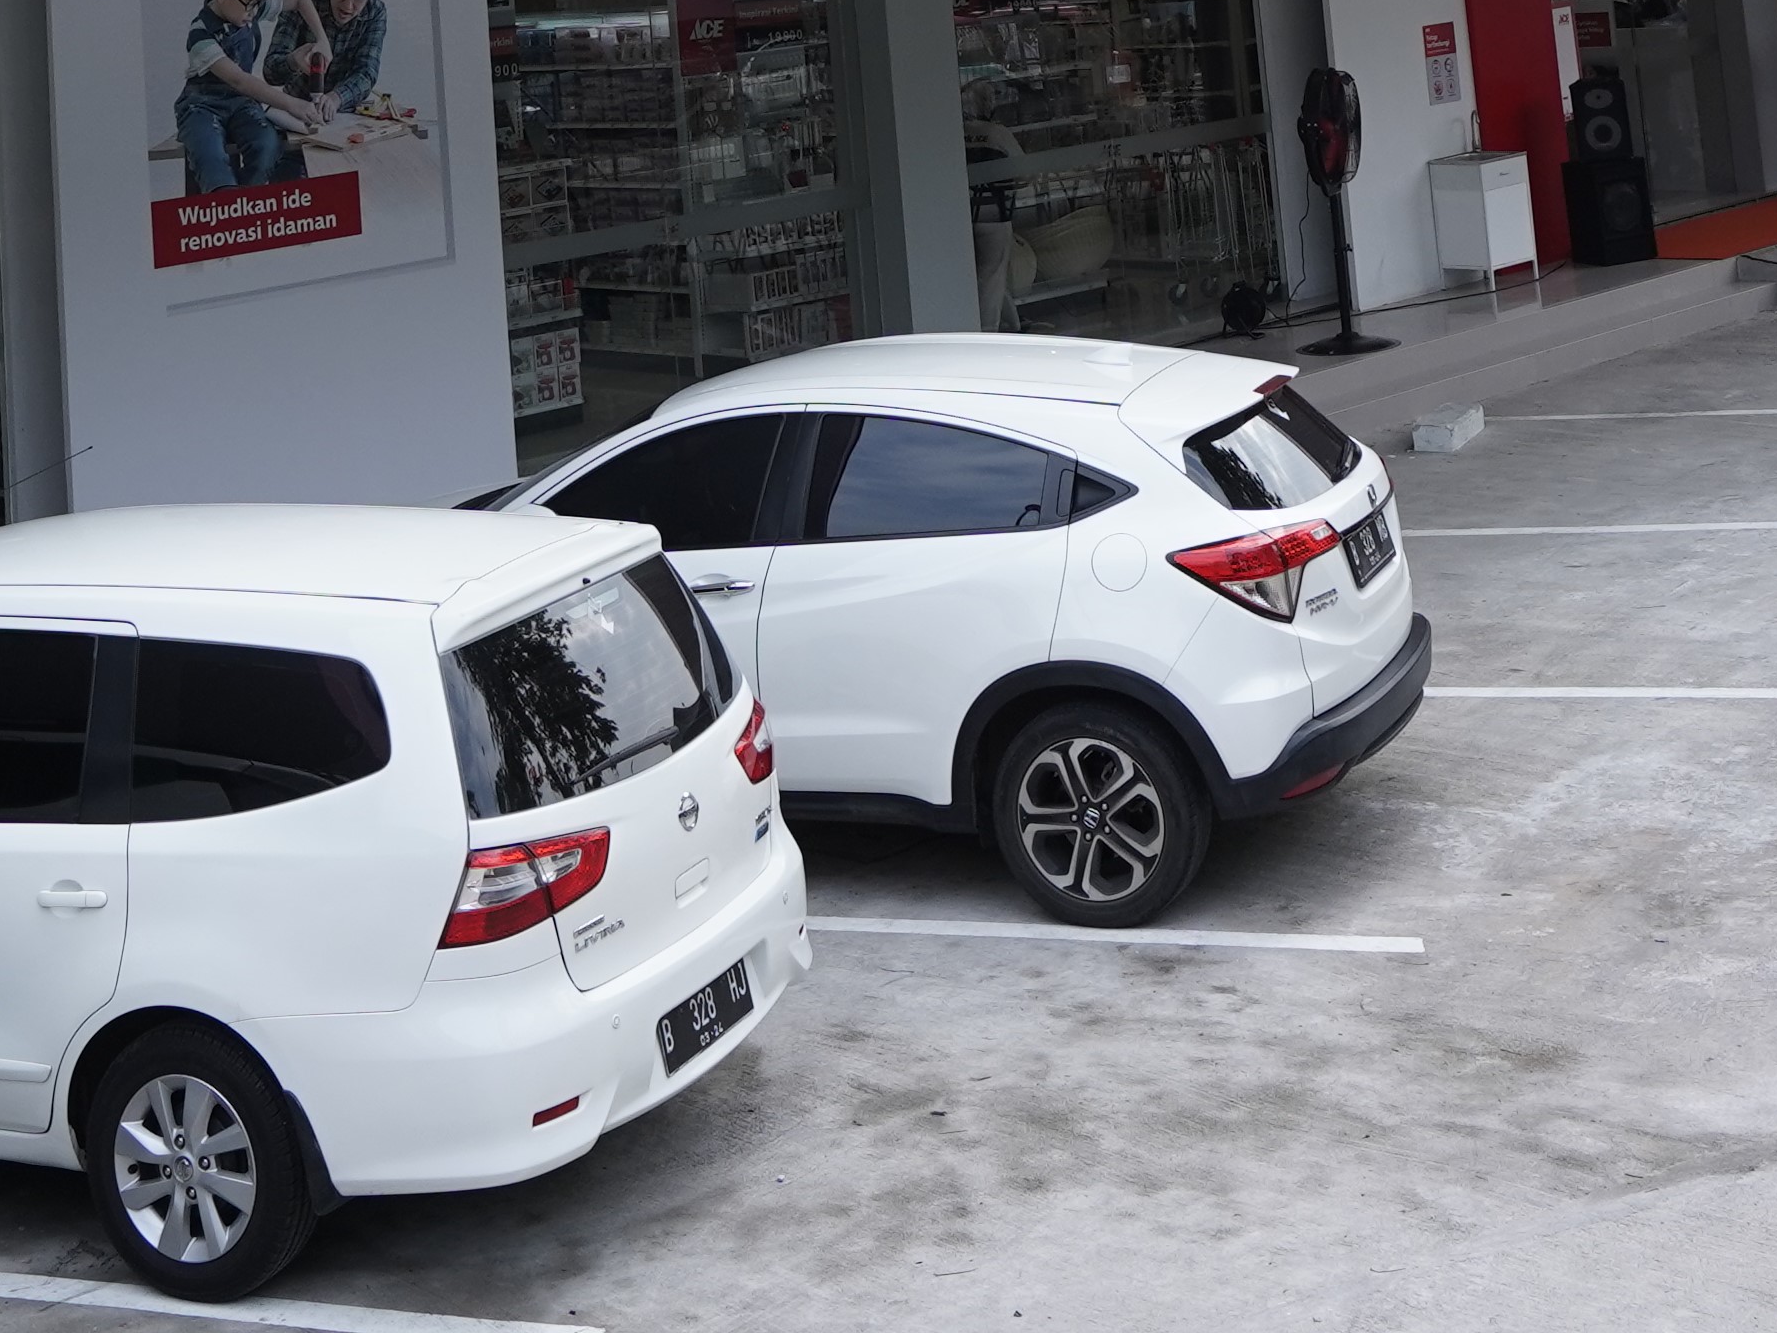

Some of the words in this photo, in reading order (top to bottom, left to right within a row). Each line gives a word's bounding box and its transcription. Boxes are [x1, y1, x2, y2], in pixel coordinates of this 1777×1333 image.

[689, 18, 725, 41] ACE
[178, 196, 276, 226] Wujudkan
[282, 189, 312, 208] ide
[178, 221, 263, 252] renovasi
[267, 211, 337, 240] idaman
[661, 1018, 675, 1054] B
[689, 986, 717, 1031] 328
[727, 962, 748, 1003] HJ
